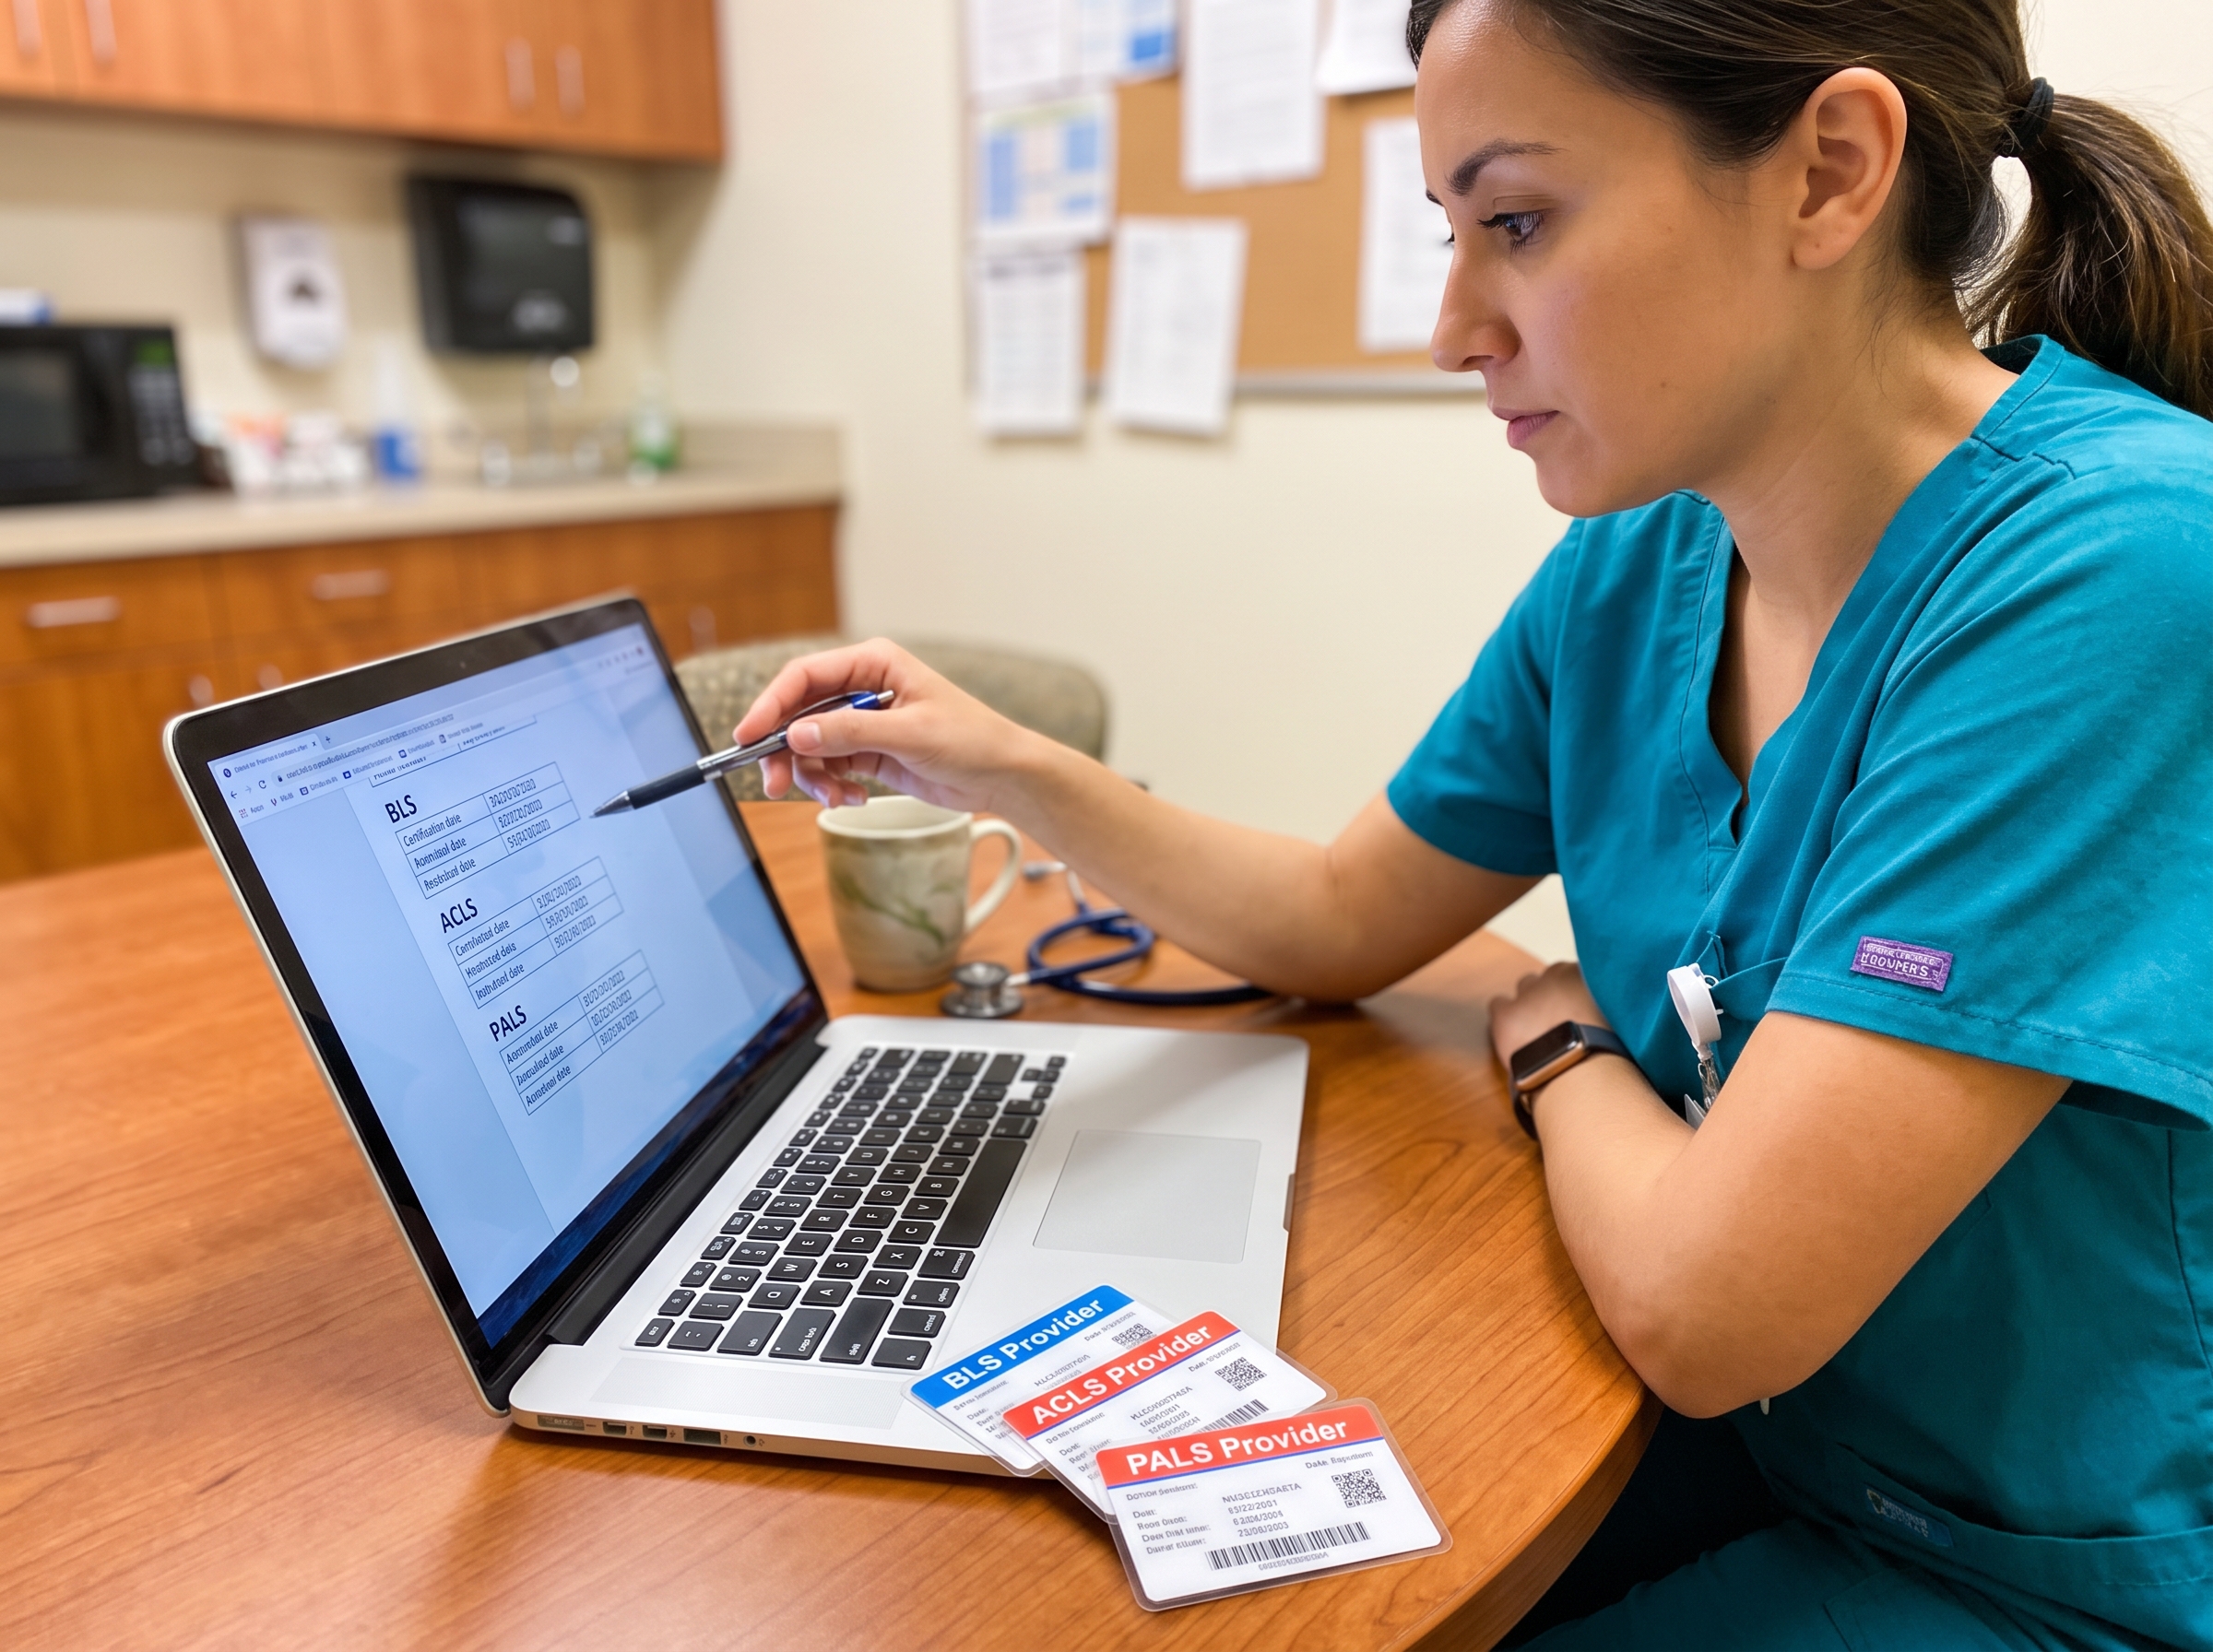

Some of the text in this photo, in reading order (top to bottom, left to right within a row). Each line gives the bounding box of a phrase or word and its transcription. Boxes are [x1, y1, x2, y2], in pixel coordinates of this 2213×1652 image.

[385, 794, 418, 823] BLS
[440, 898, 479, 933] ACLS
[489, 1005, 527, 1042] PALS
[941, 1354, 1002, 1390] BLS
[1000, 1299, 1104, 1359] Provider
[1032, 1377, 1107, 1425] ACLS
[1105, 1326, 1213, 1386] Provider
[1126, 1442, 1213, 1475] PALS
[1219, 1419, 1347, 1459] Provider
